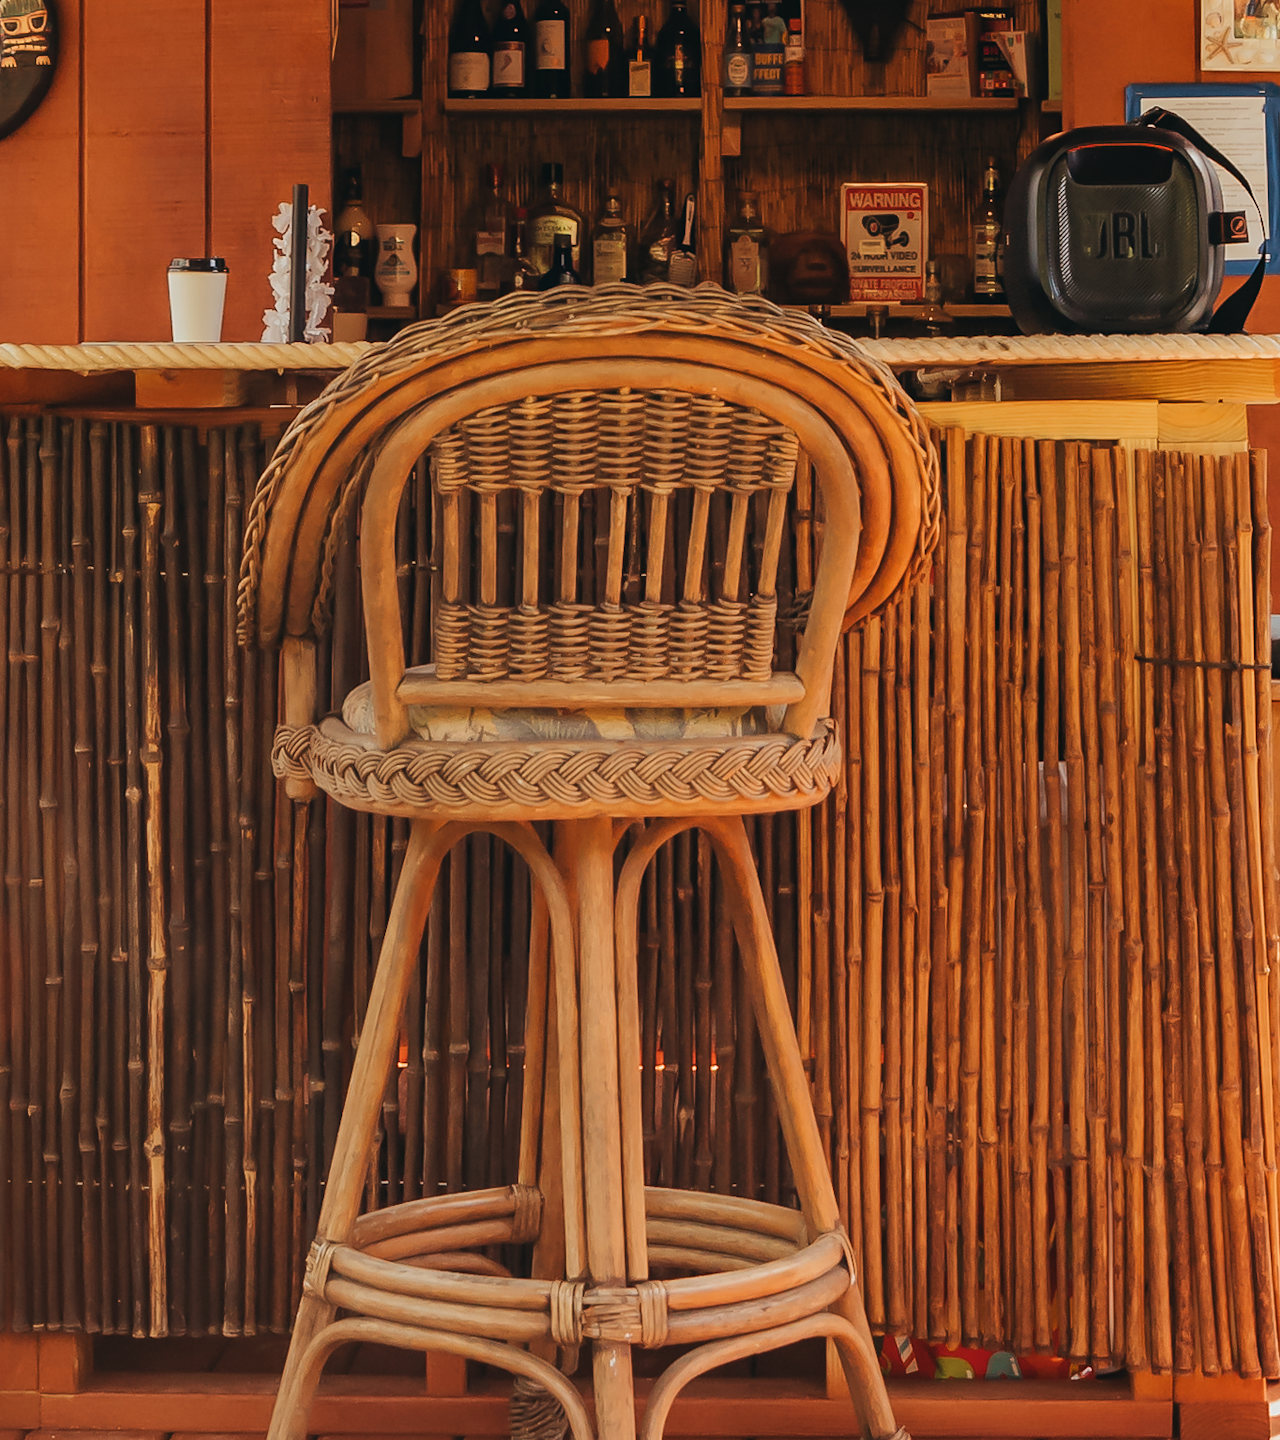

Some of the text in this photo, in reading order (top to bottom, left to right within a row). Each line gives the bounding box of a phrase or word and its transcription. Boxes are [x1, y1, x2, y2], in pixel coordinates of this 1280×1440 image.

[849, 191, 921, 209] WARNING
[1083, 210, 1166, 260] JBL
[850, 251, 861, 261] 24
[890, 251, 918, 261] VIDEO
[851, 265, 917, 273] SURVEILLANCE
[850, 278, 880, 289] RIVATE
